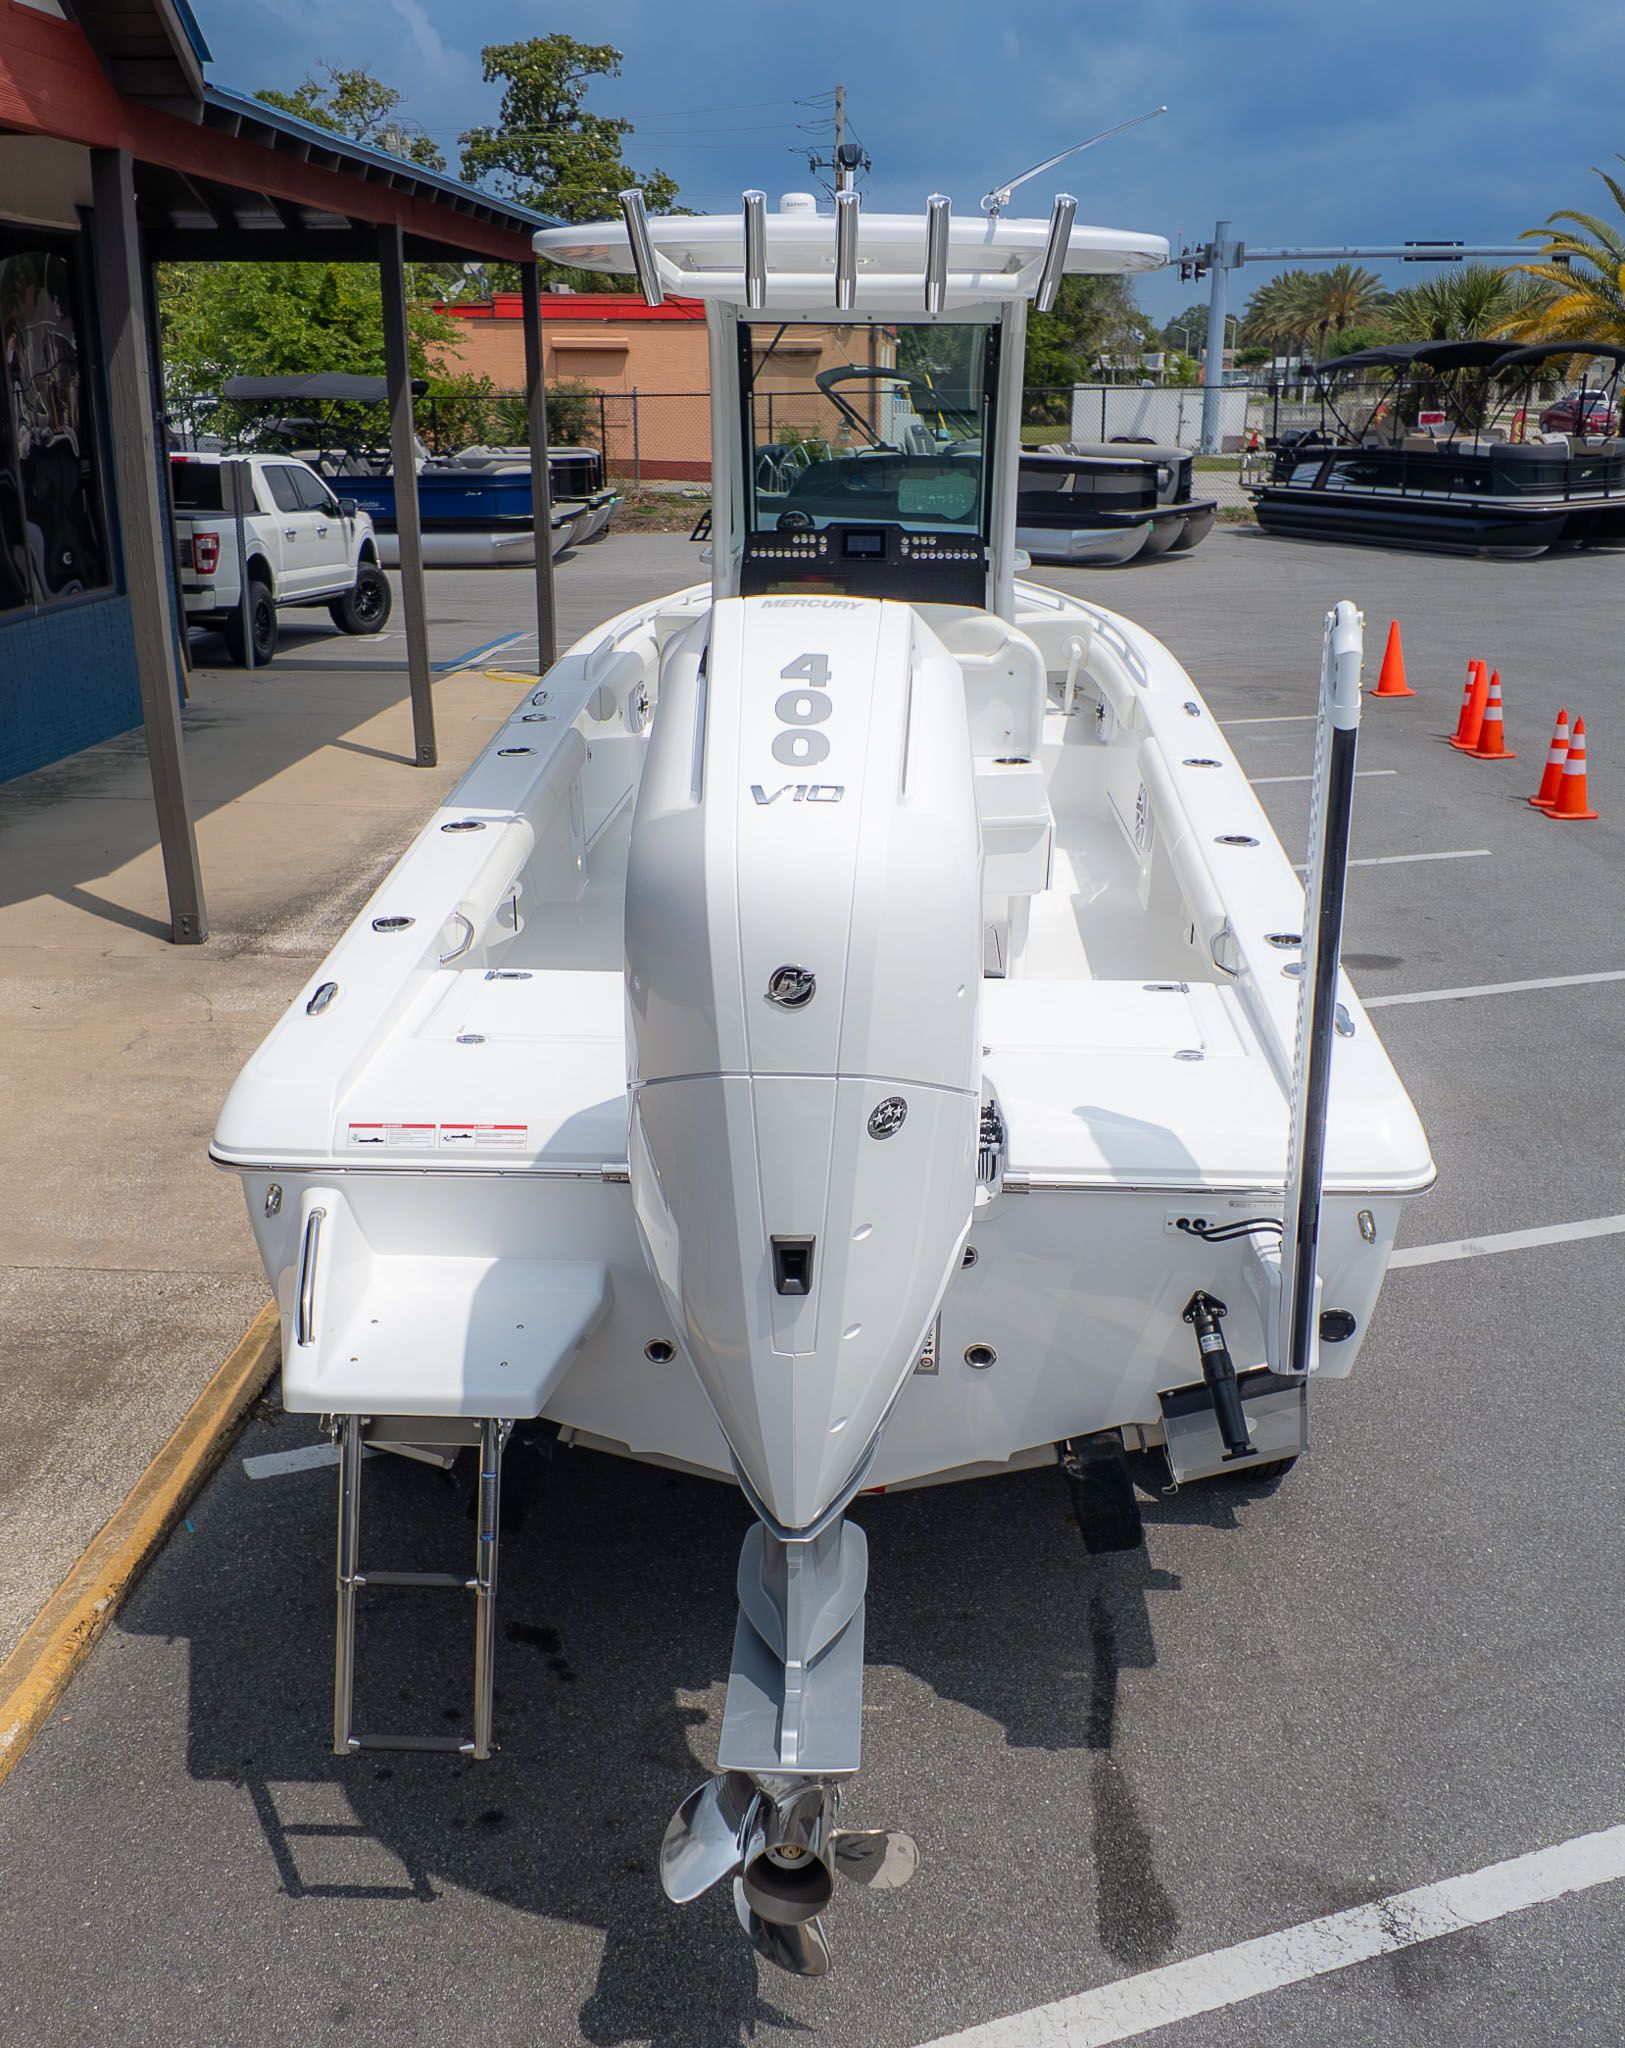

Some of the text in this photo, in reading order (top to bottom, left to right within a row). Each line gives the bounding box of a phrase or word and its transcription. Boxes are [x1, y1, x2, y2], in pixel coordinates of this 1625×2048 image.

[760, 599, 864, 610] MERCURY
[771, 653, 832, 767] 400
[750, 785, 845, 805] V10
